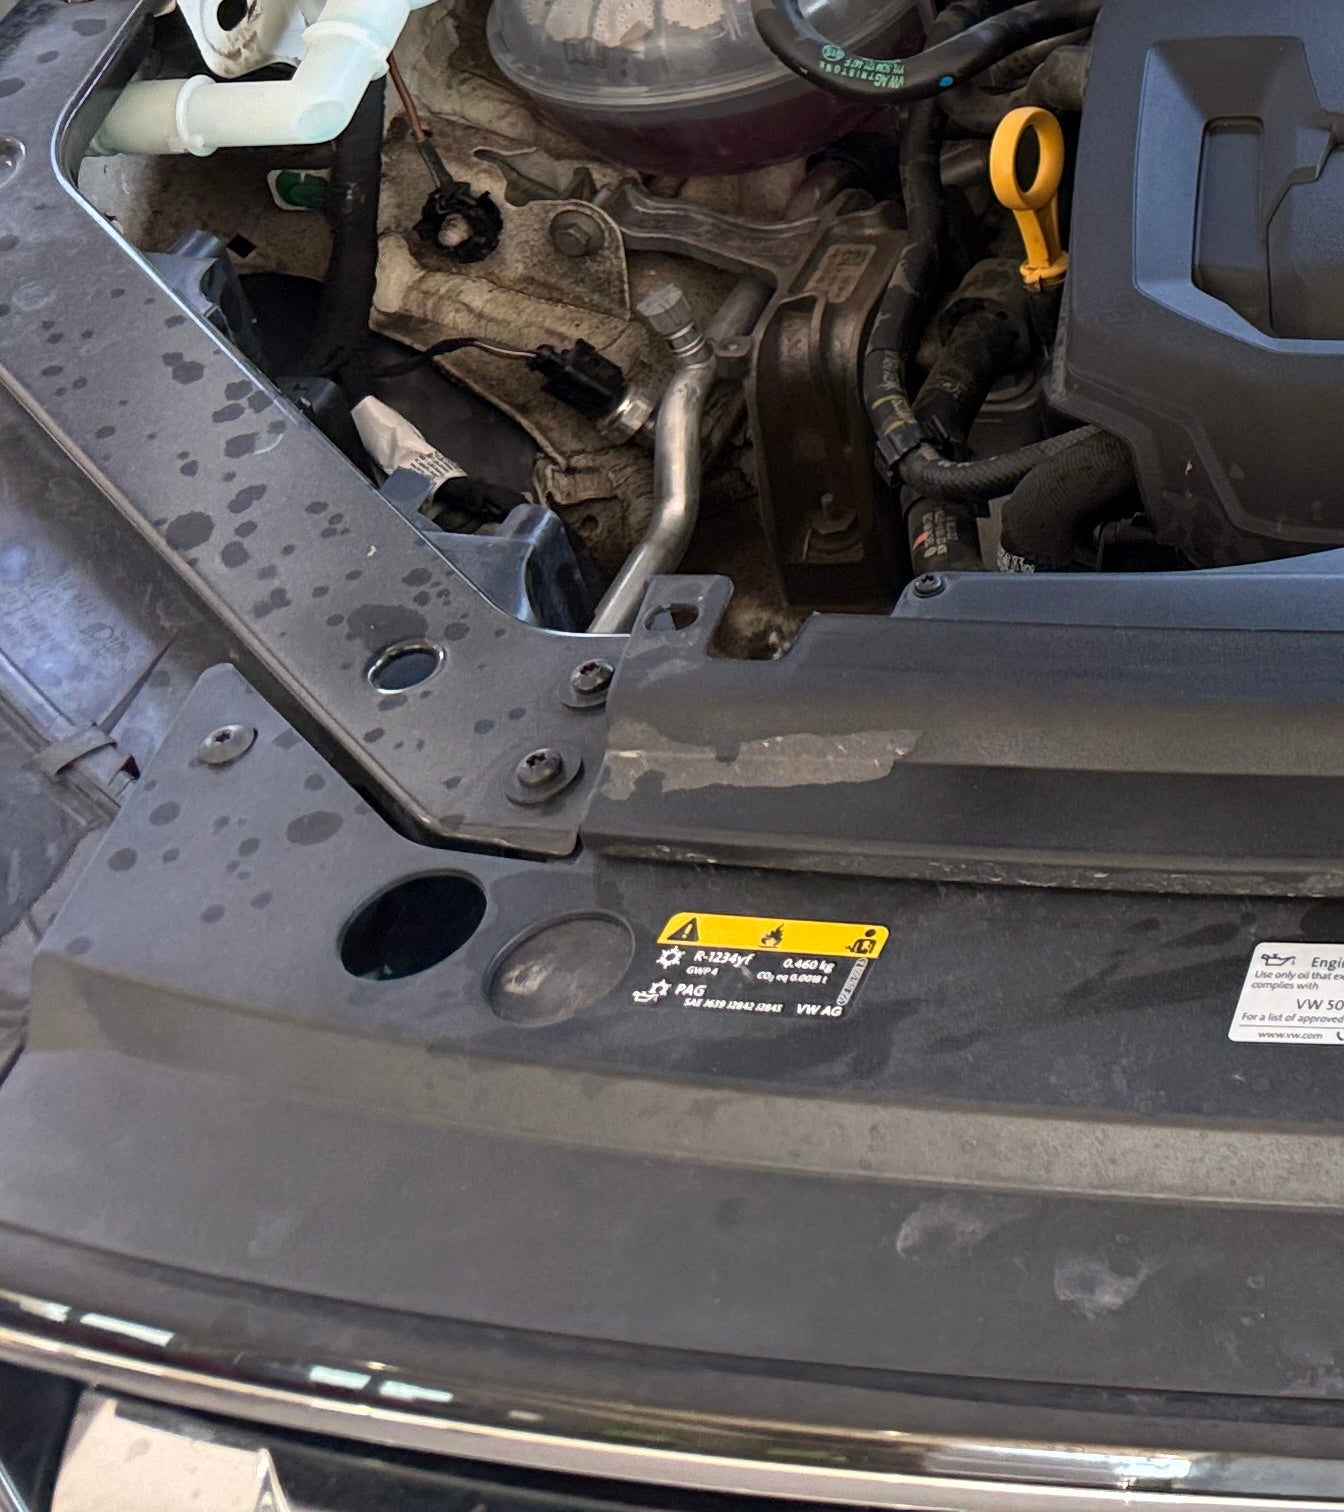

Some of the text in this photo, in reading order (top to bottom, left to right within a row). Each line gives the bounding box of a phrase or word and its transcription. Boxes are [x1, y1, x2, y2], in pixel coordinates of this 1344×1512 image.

[693, 950, 756, 968] R-1234yf
[1254, 970, 1274, 979] Use
[1274, 970, 1297, 981] only
[1297, 971, 1310, 980] oil
[1311, 971, 1332, 980] that
[674, 983, 708, 997] PAG
[1250, 981, 1319, 991] complies with
[796, 1003, 844, 1017] VW AG
[1296, 998, 1324, 1010] VW
[1241, 1012, 1258, 1021] For
[1267, 1012, 1284, 1022] list
[1284, 1013, 1298, 1022] of
